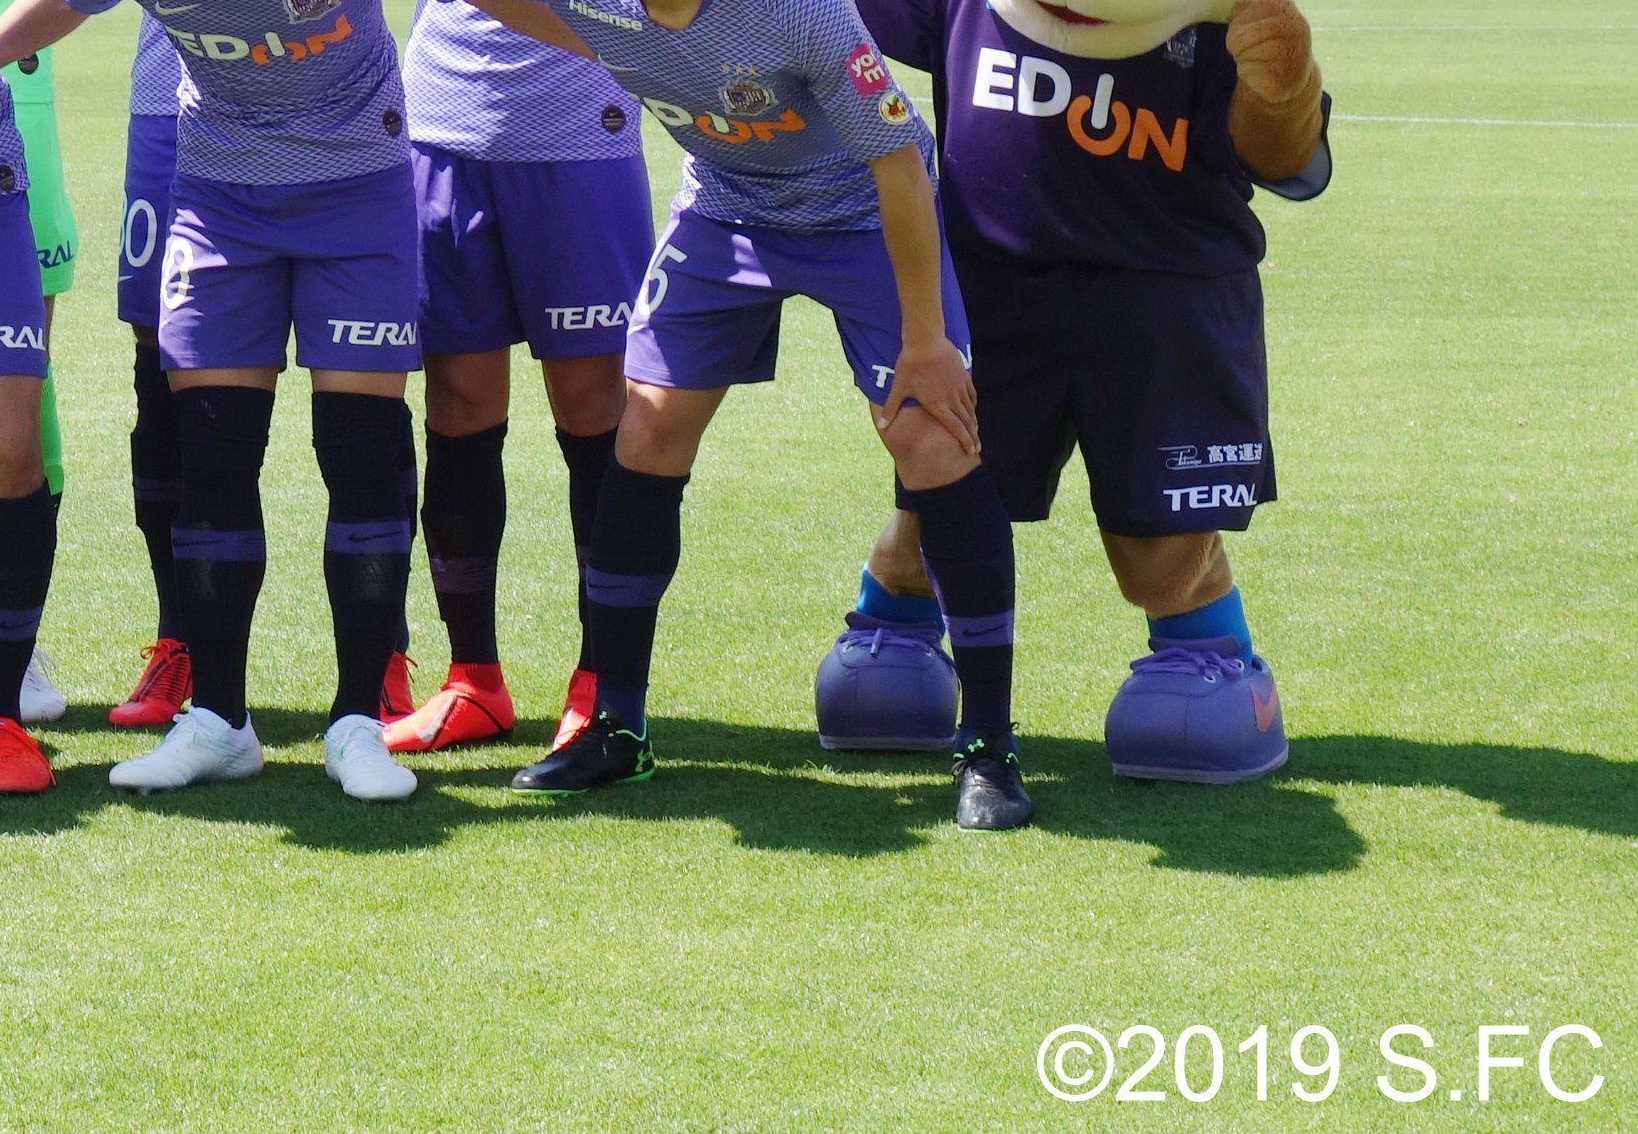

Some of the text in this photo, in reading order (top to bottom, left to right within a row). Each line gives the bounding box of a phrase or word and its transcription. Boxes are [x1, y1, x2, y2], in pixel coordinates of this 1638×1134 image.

[626, 91, 806, 145] DION
[973, 47, 1189, 172] EDION
[36, 239, 74, 269] RAL
[545, 302, 633, 331] TERA
[1163, 483, 1258, 512] TERAL
